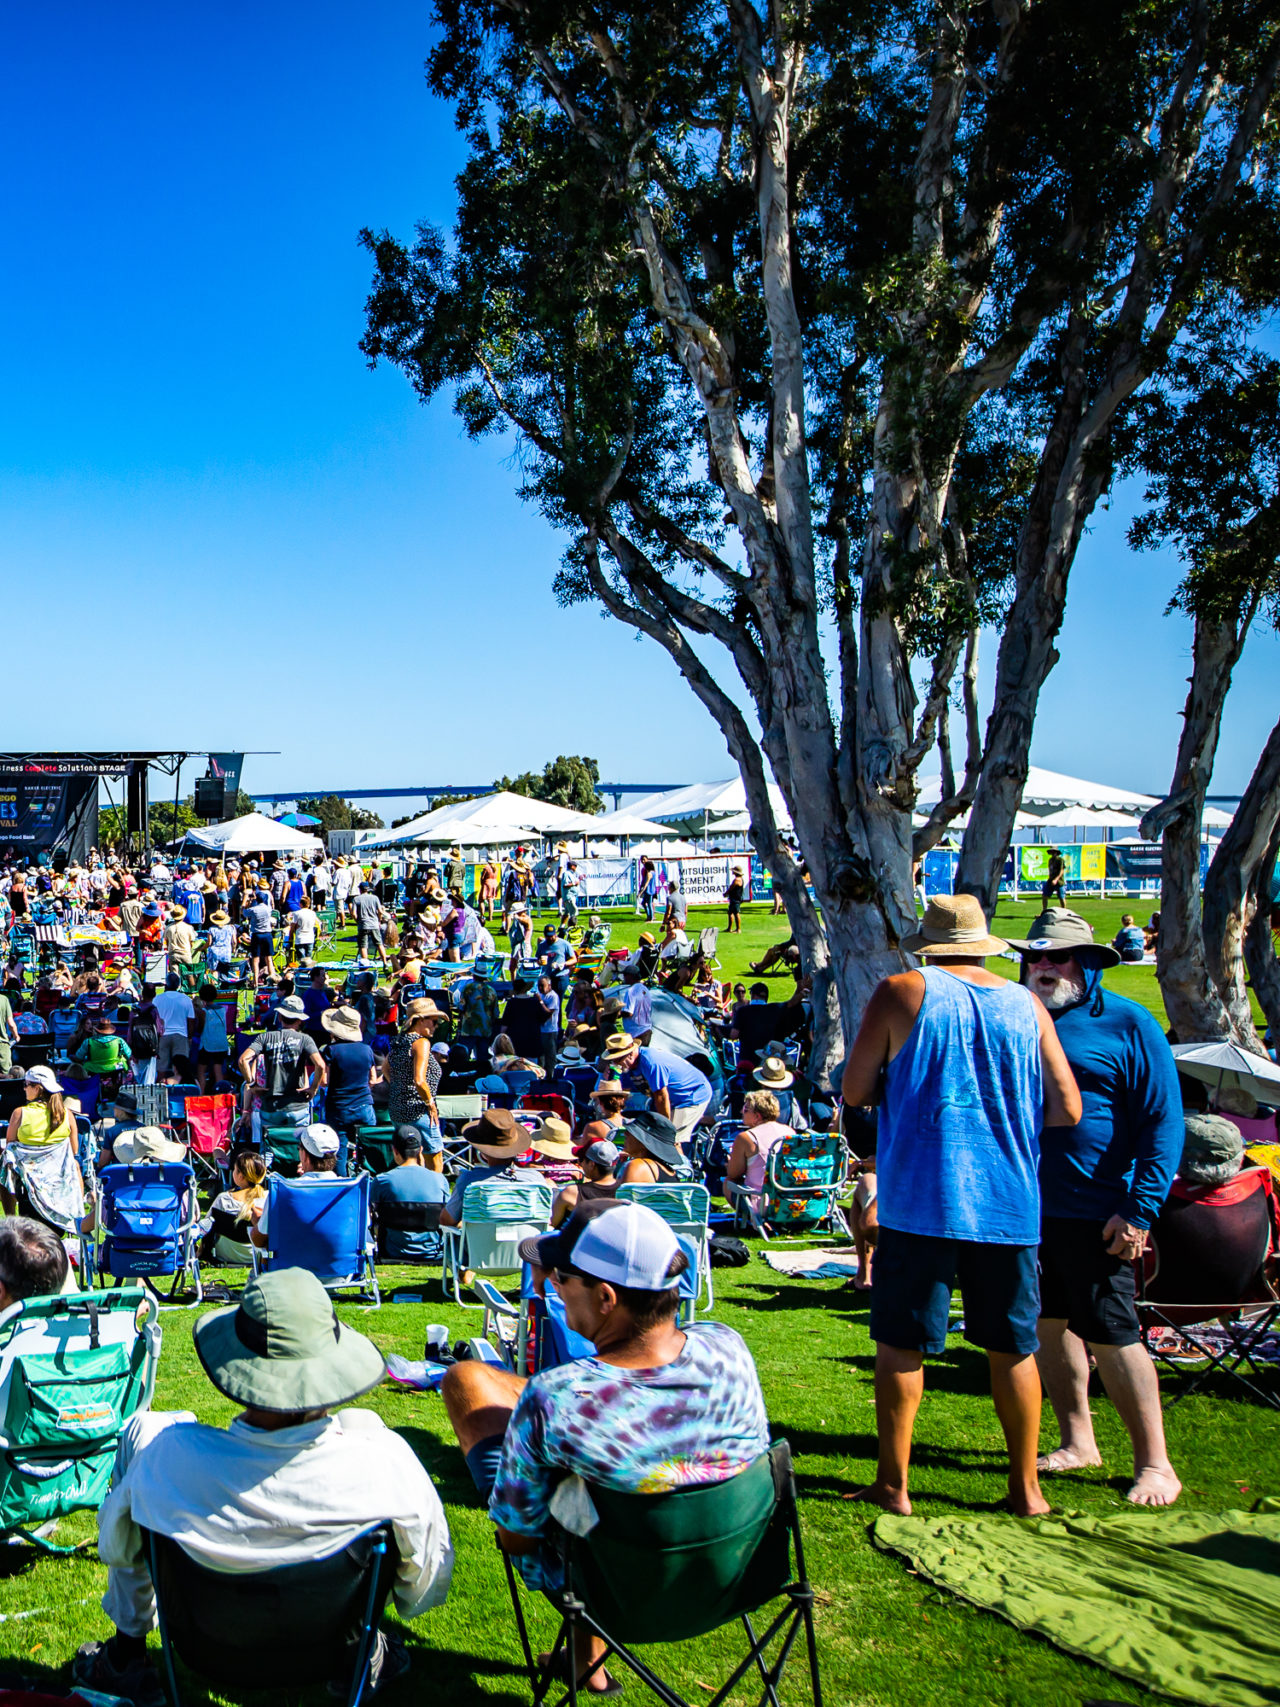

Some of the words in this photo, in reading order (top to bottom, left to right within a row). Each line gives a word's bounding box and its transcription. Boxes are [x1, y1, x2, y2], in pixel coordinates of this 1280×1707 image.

[24, 765, 58, 773] Complete
[679, 866, 728, 876] MITSUBISHI
[679, 876, 714, 886] CEMENT
[29, 1491, 52, 1505] Time
[52, 1487, 64, 1500] to
[65, 1479, 87, 1501] Chill
